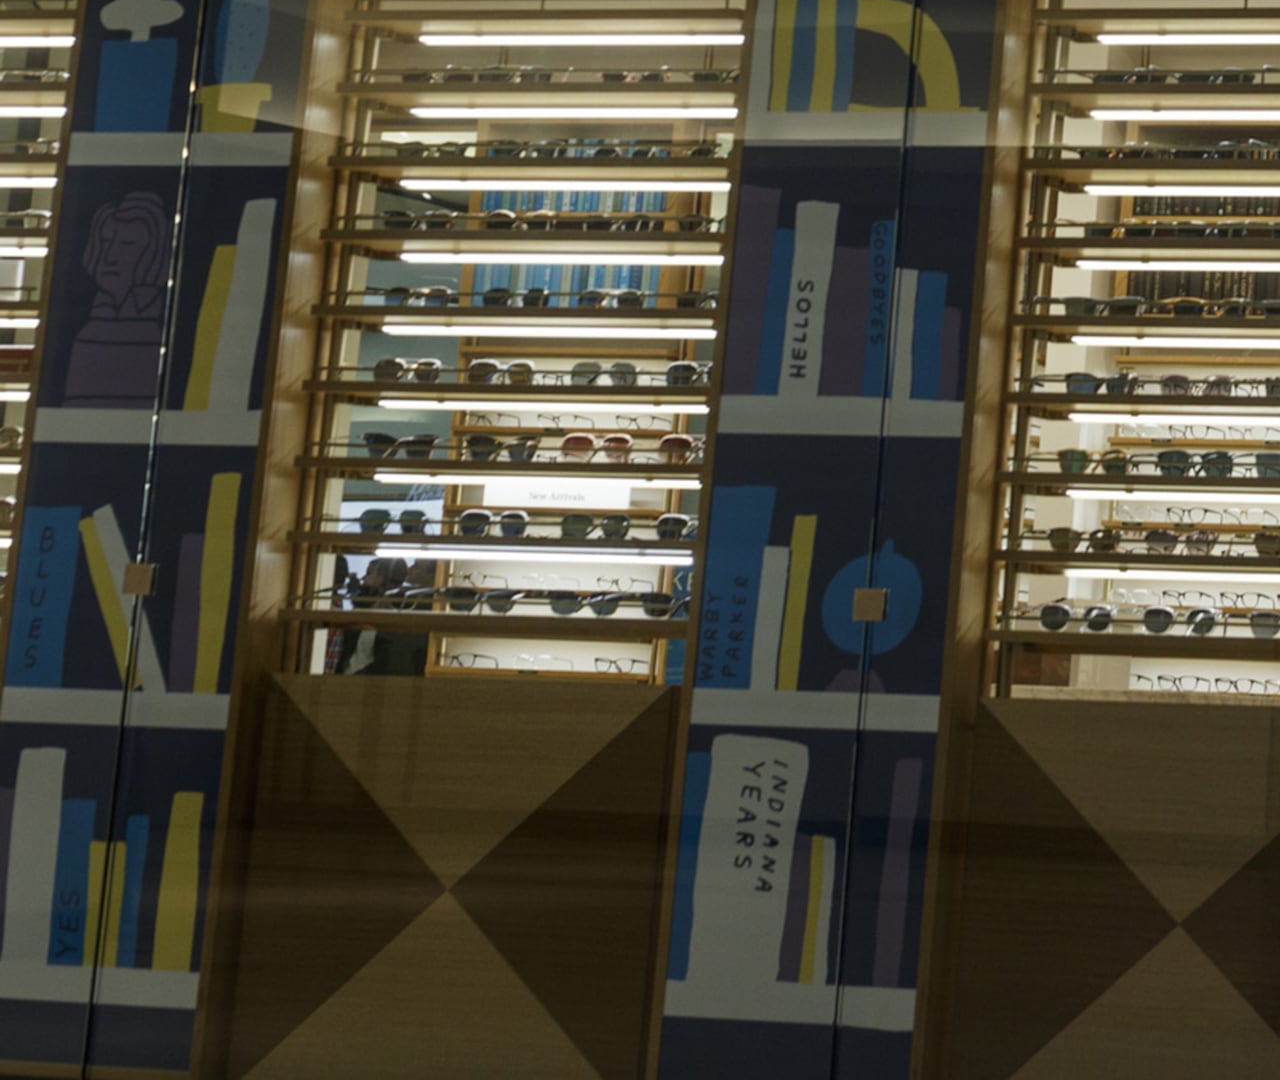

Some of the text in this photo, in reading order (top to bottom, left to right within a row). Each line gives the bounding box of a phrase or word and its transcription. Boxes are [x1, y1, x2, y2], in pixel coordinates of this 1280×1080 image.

[789, 278, 814, 378] HELLOS
[24, 525, 56, 669] BLUES
[700, 592, 721, 680] WARBY
[722, 576, 749, 677] PARKER
[733, 760, 764, 871] YEARS
[754, 758, 787, 894] INDIANA
[54, 888, 82, 958] YES
